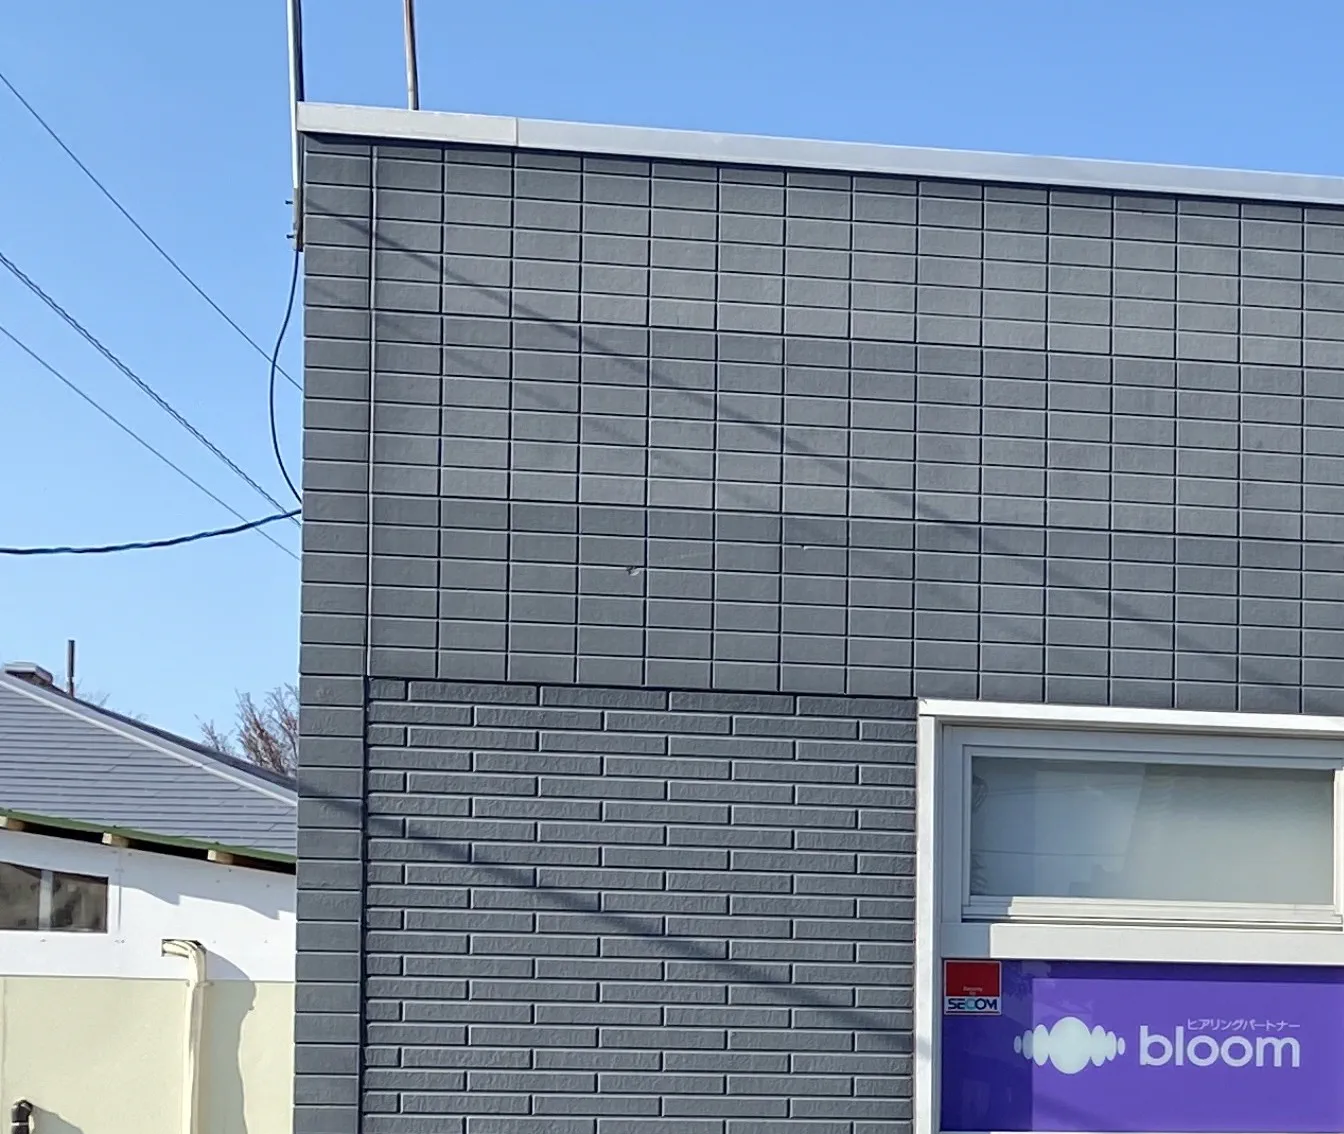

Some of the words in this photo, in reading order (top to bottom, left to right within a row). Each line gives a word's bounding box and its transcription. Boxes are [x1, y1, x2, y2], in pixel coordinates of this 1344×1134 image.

[948, 998, 997, 1010] SECOM
[1187, 1018, 1300, 1031] ヒアリングパートナー
[1139, 1025, 1300, 1068] bloom
